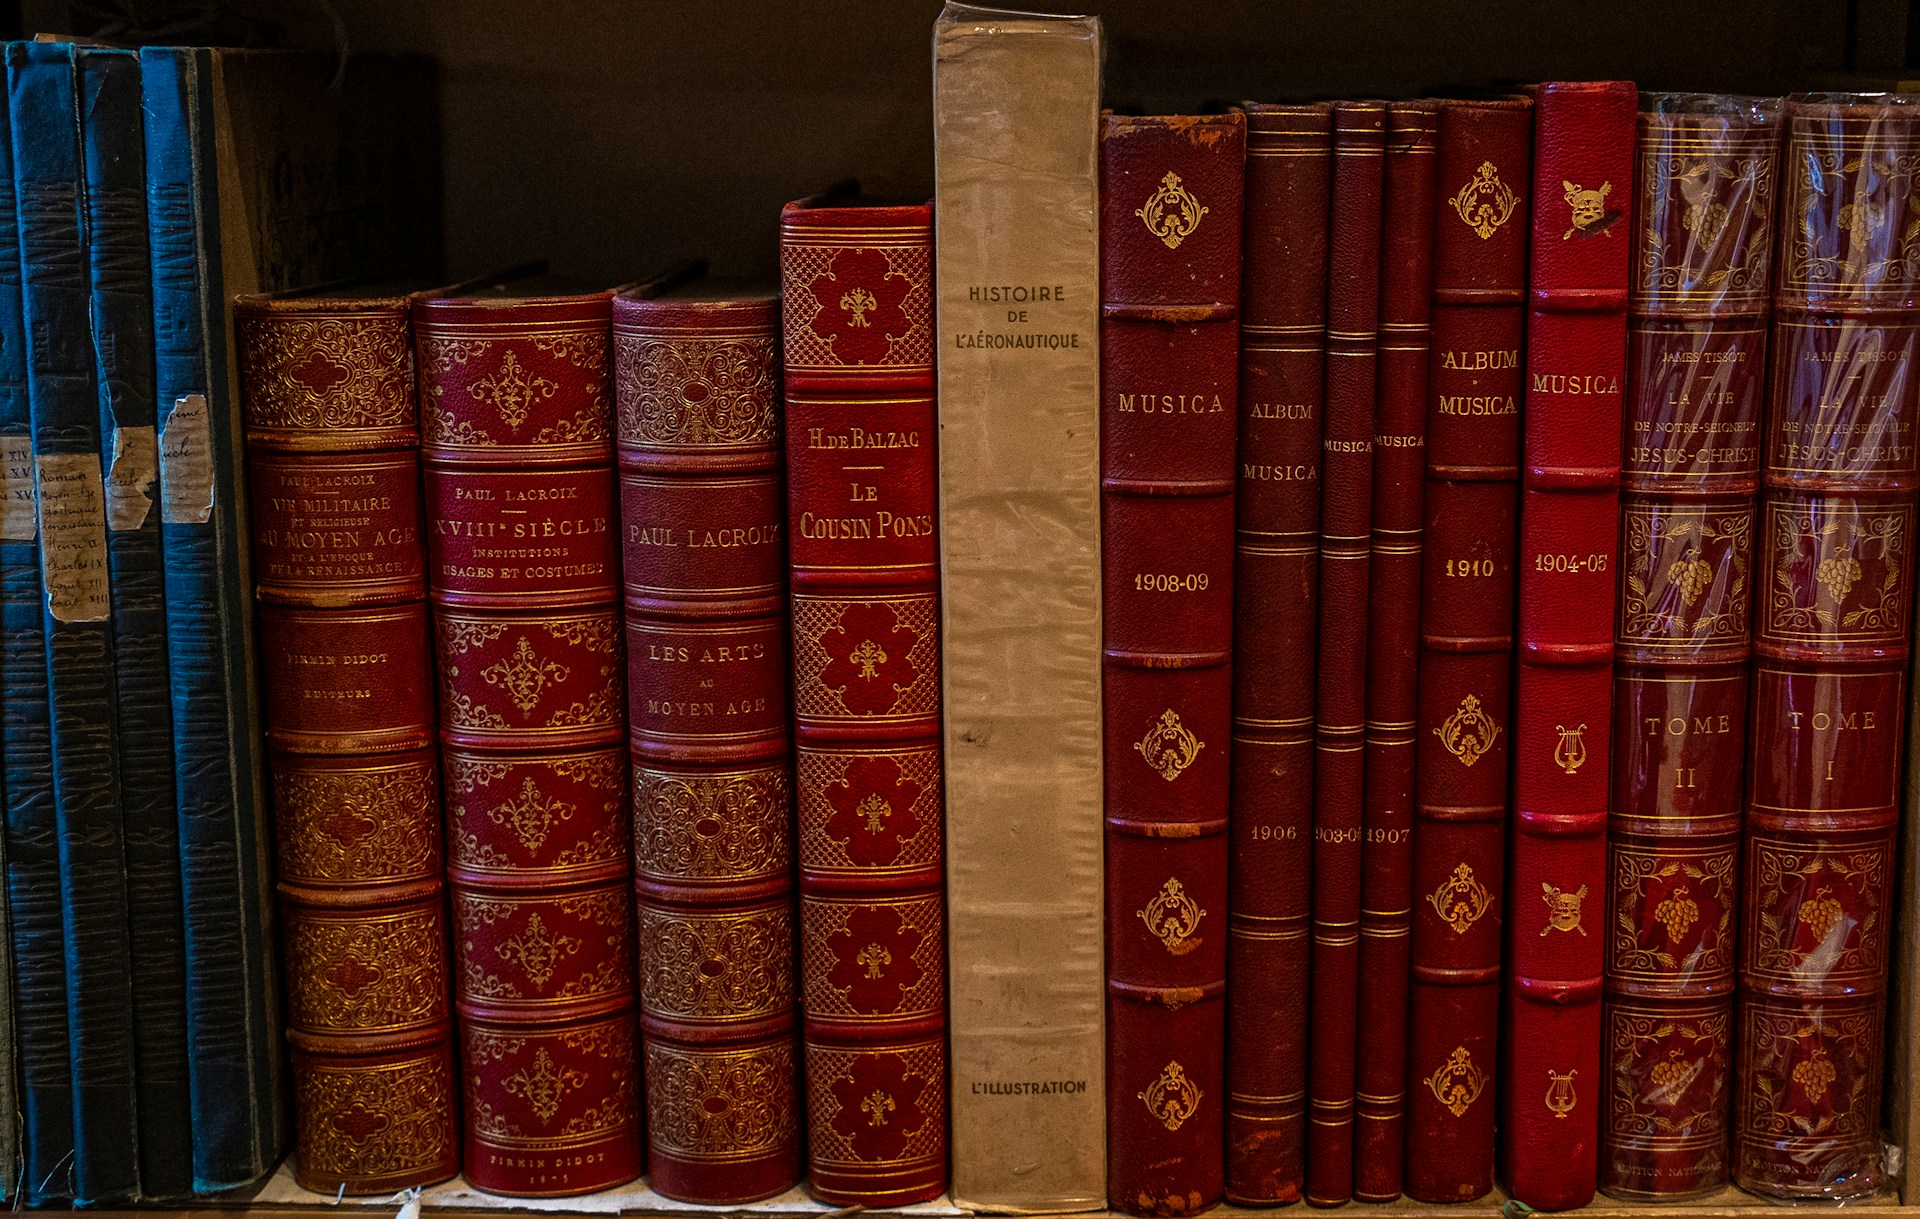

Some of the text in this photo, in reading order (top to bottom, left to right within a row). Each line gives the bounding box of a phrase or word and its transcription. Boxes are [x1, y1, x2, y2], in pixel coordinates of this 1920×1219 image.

[969, 286, 1064, 302] HISTOIRE
[1007, 310, 1028, 323] DE
[956, 330, 1079, 350] L'AÉRONAUTIQUE
[1442, 350, 1518, 370] ALBUM
[1663, 351, 1746, 363] JAMES TISSOT
[1804, 351, 1849, 363] JAMES
[1533, 373, 1619, 395] MUSICA
[1118, 393, 1224, 414] MUSICA
[1438, 395, 1518, 416] MUSICA
[1668, 392, 1735, 405] LA VIE
[1250, 403, 1313, 420] ALBUM
[1634, 422, 1650, 432] DE
[1782, 421, 1798, 432] DE
[850, 427, 919, 449] BALZAC
[1323, 439, 1373, 453] MUSICA
[1374, 434, 1424, 448] MUSICA
[40, 469, 87, 483] Roman
[1243, 463, 1317, 481] MUSICA
[316, 475, 375, 486] LACROIX
[455, 487, 578, 501] PAUL LACROIX
[850, 483, 878, 502] LE
[304, 497, 391, 512] MILITAIRE
[310, 518, 370, 528] RELIGIEUSE
[514, 518, 606, 538] SIÈCLE
[800, 511, 933, 539] COUSIN PONS
[287, 531, 360, 549] MOYEN
[374, 528, 414, 546] AGE
[629, 523, 781, 547] PAUL LACROIX
[472, 548, 569, 558] INSTITUTIONS
[307, 563, 403, 576] RENAISSANCE
[442, 563, 603, 579] USAGES ET COSTUMES
[1446, 559, 1494, 577] 1910
[1535, 553, 1608, 573] 1904-05
[1135, 573, 1209, 592] 1908-09
[343, 653, 388, 665] DIDOT
[649, 644, 764, 662] LES ARTS
[699, 679, 714, 688] AU
[648, 698, 765, 716] MOYEN AGE
[1645, 715, 1730, 736] TOME
[1788, 711, 1876, 731] TOME
[1675, 768, 1695, 788] II
[1826, 760, 1834, 781] I
[1251, 825, 1297, 841] 1906
[1366, 828, 1410, 844] 1907
[971, 1081, 1086, 1095] L'ILLUSTRATION
[490, 1152, 605, 1168] FIRMIN DIDOT
